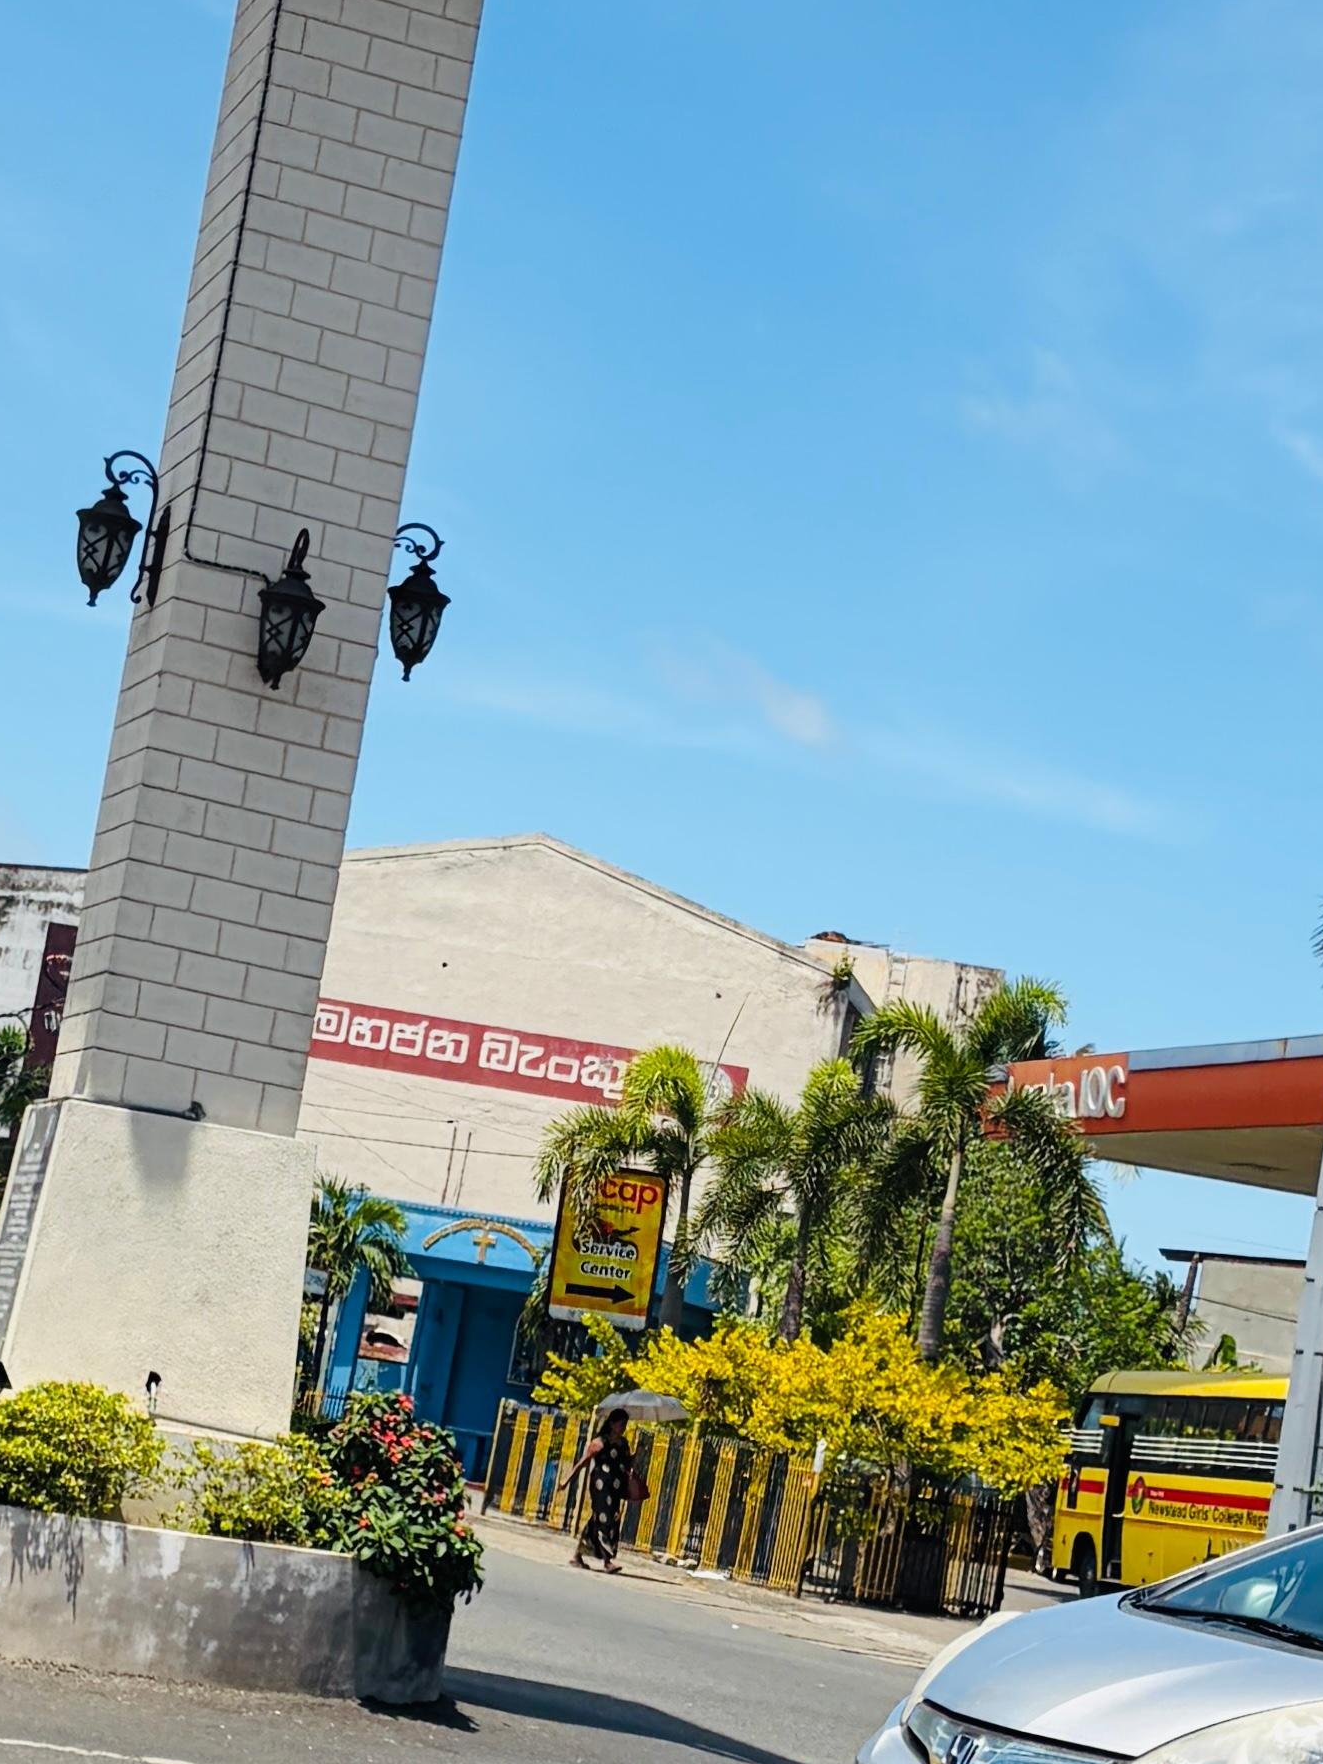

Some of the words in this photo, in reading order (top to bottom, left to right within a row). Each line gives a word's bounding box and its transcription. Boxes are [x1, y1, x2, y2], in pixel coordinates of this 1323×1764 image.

[313, 1004, 469, 1063] මහජන
[478, 1031, 628, 1100] බැංකු
[581, 1240, 636, 1260] Service
[580, 1261, 631, 1279] Center
[1213, 1507, 1244, 1527] College
